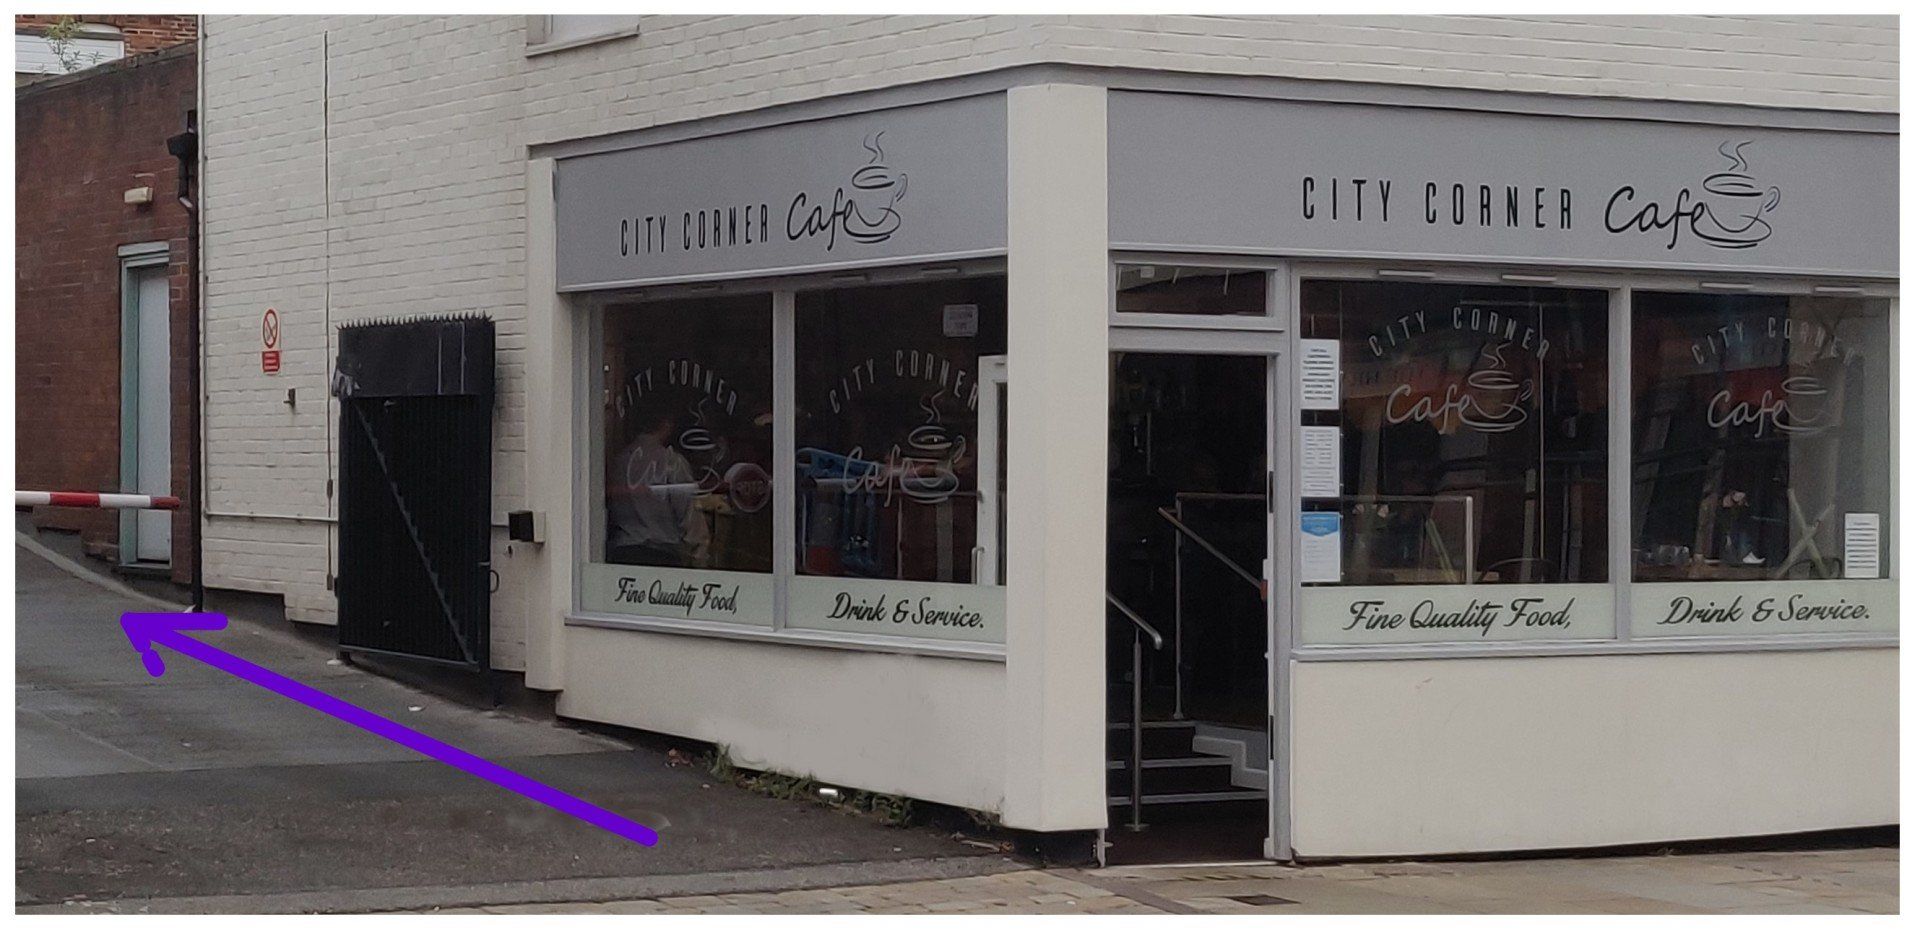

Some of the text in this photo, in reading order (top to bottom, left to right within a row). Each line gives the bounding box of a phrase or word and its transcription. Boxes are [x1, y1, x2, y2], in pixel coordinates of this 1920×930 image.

[1302, 175, 1393, 222] CITY
[1425, 181, 1573, 230] CORNER
[620, 215, 668, 257] CITY
[682, 204, 770, 251] CORNER
[1368, 306, 1549, 360] CITY CORNER
[1691, 316, 1856, 367] CITY CORNER
[615, 359, 737, 418] CITY CORNER
[829, 349, 979, 414] CITY CORNER
[615, 577, 739, 616] Fine Quality Food,
[826, 592, 985, 629] Drink & Service.
[1342, 597, 1577, 637] Fine Quality Food,
[1656, 593, 1871, 625] Drink & Service.
